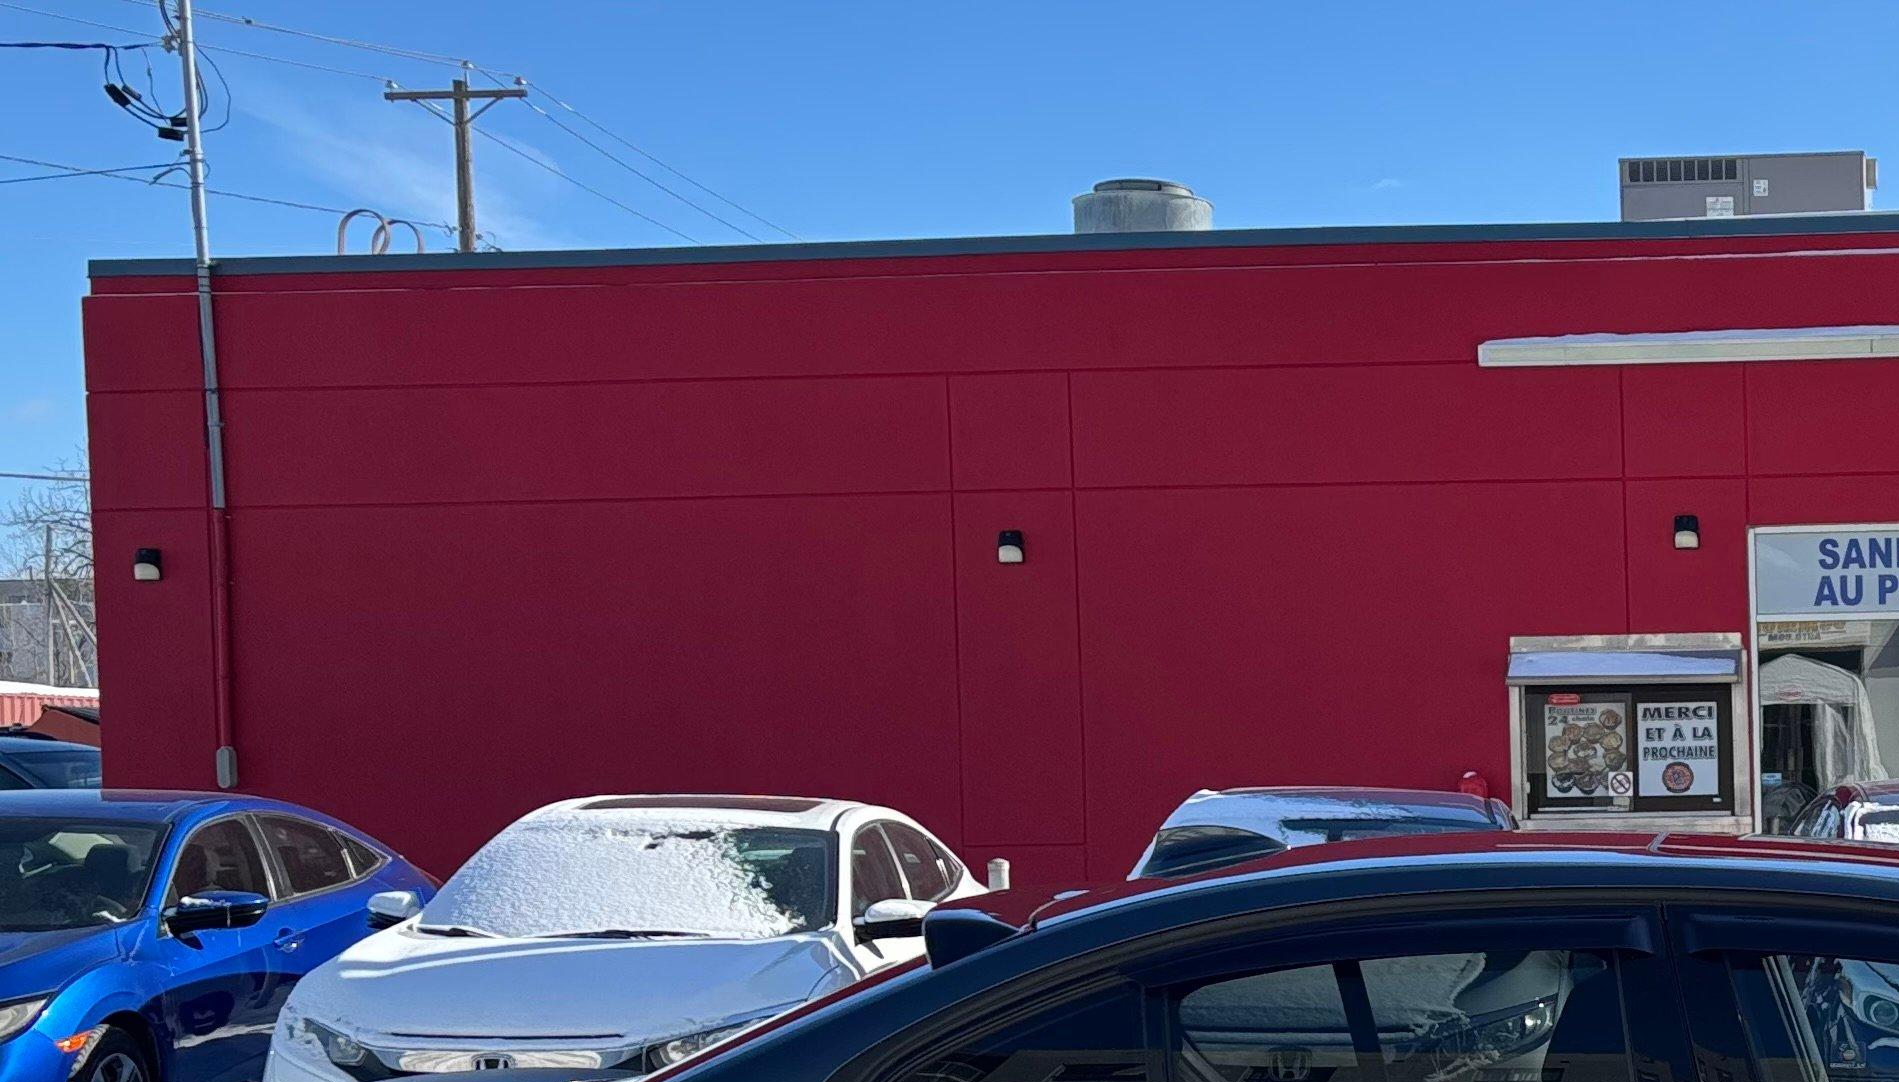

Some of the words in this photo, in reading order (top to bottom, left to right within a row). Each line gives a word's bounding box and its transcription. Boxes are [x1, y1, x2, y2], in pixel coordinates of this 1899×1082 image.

[1813, 574, 1864, 607] AU
[1548, 715, 1569, 726] 24
[1642, 705, 1714, 721] MERCI
[1646, 727, 1666, 742] ET
[1671, 723, 1686, 742] À
[1692, 726, 1714, 742] LA
[1642, 745, 1716, 761] PROCHAINE
